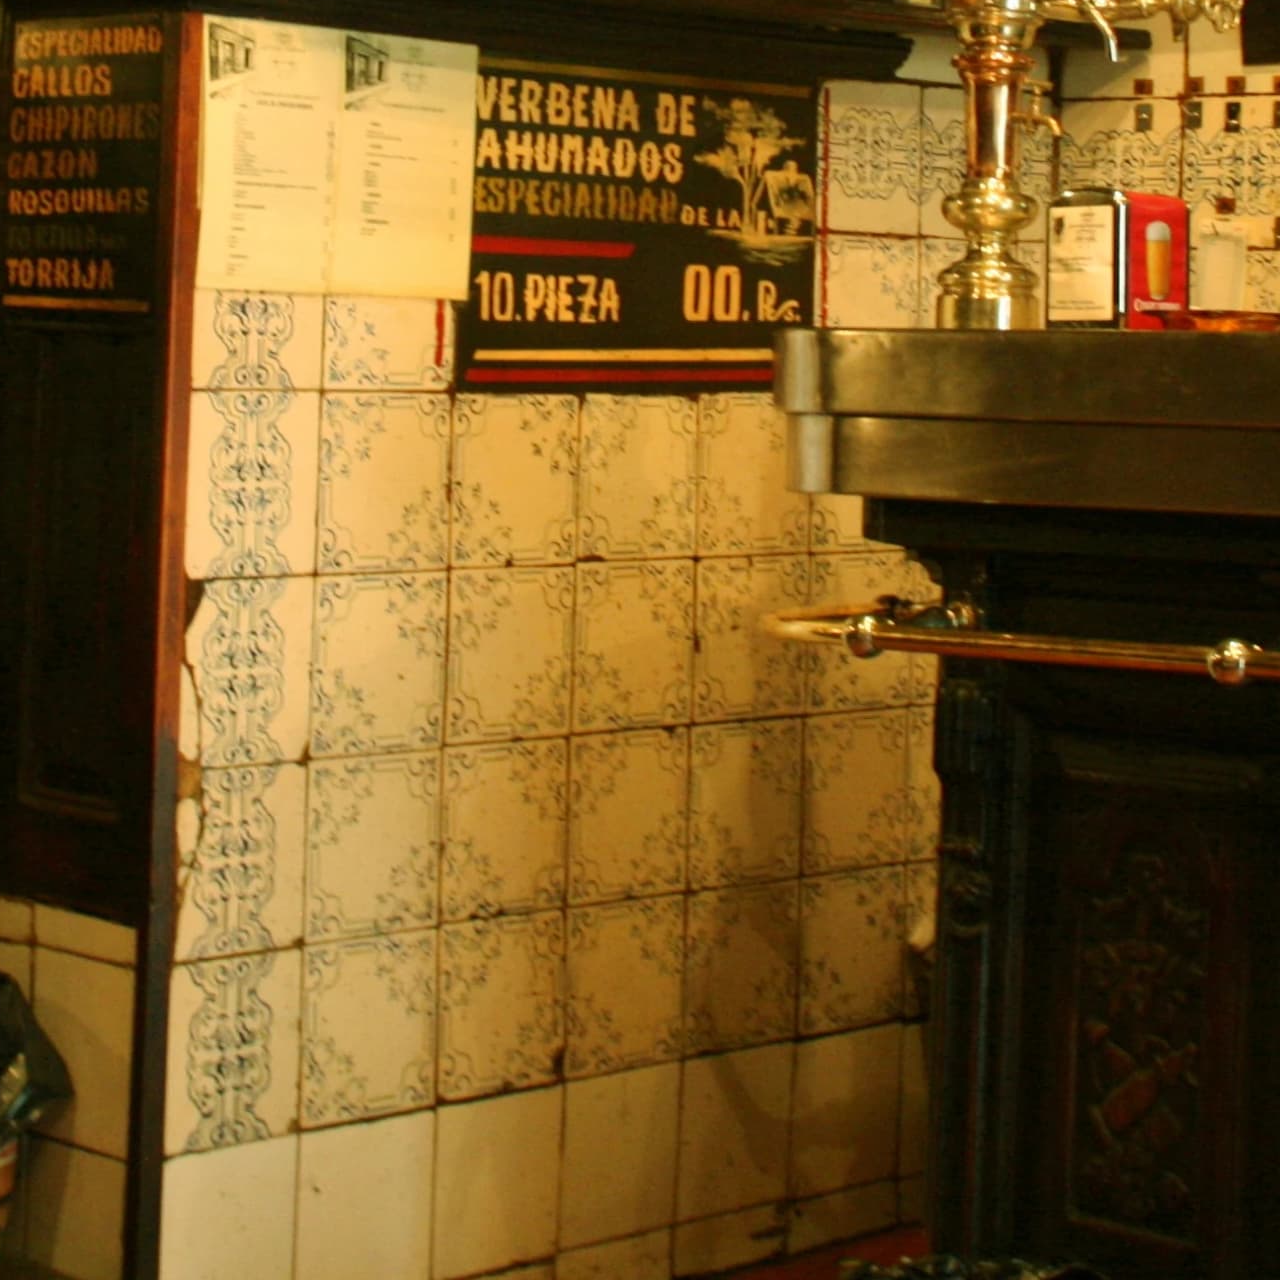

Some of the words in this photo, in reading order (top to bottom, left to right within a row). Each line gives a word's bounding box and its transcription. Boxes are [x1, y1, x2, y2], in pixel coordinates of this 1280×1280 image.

[19, 27, 163, 60] ESPECIALIDAD
[12, 64, 112, 98] CALLOS
[475, 75, 640, 133] VERBENA
[656, 92, 698, 137] DE
[475, 127, 684, 184] AHUMADOS
[680, 204, 710, 226] DE
[717, 207, 741, 227] LA
[5, 258, 115, 288] TORRIJA
